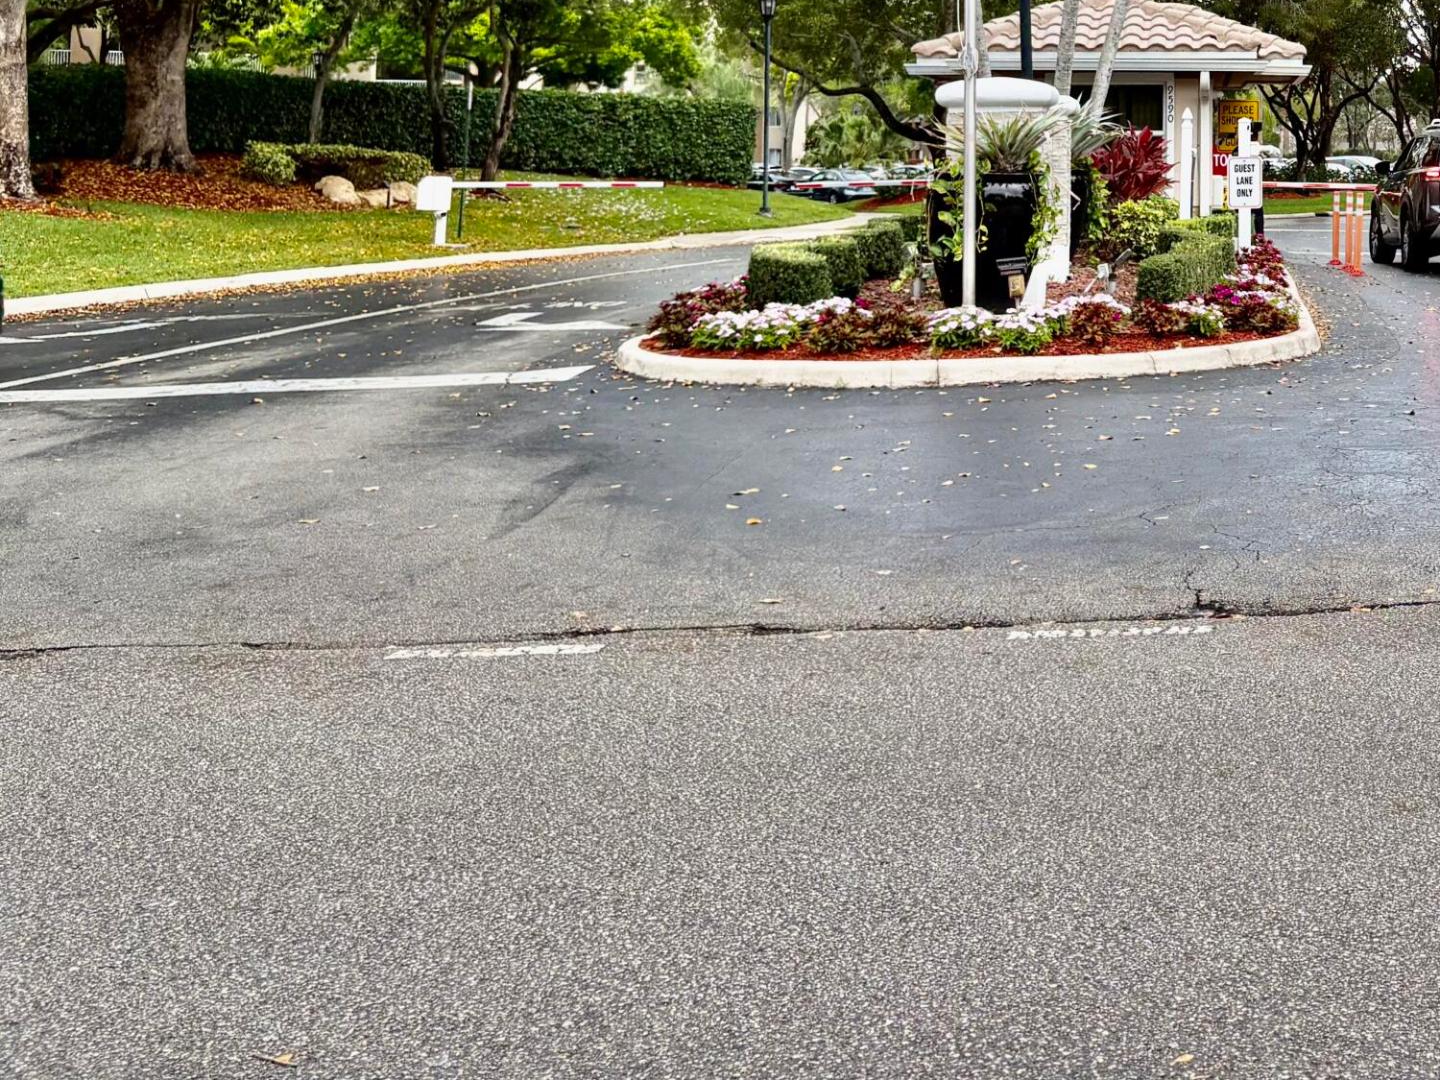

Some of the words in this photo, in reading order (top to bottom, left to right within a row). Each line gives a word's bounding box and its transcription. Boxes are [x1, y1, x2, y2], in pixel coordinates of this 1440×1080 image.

[1222, 105, 1254, 114] PLEASE
[1234, 163, 1255, 173] GUEST
[1236, 176, 1253, 185] LANE
[1236, 188, 1253, 198] ONLY
